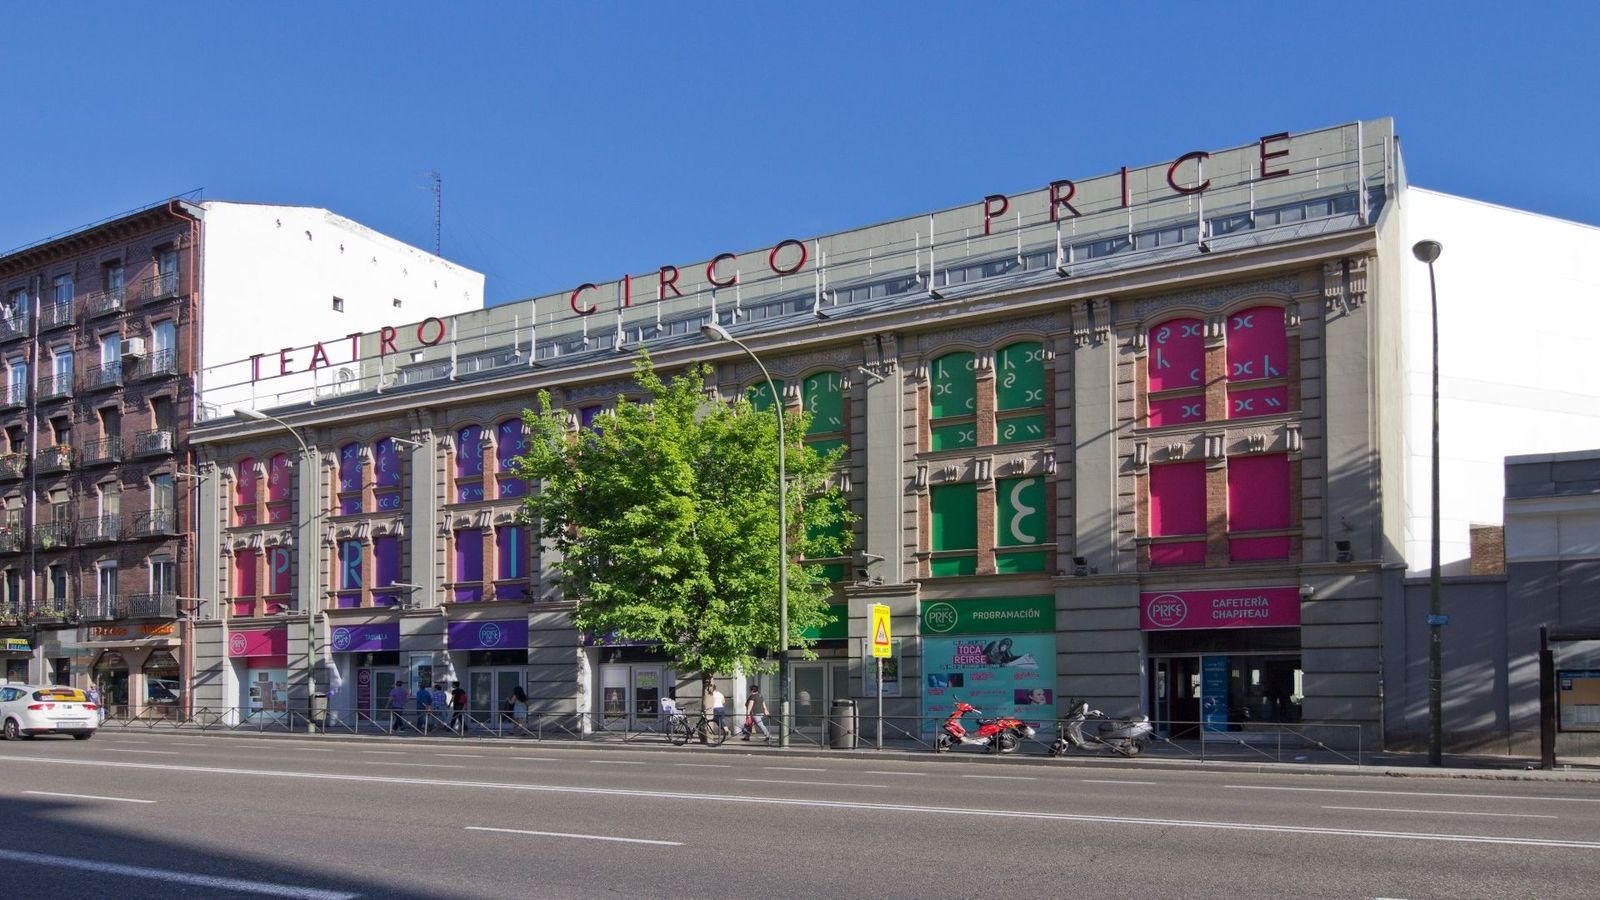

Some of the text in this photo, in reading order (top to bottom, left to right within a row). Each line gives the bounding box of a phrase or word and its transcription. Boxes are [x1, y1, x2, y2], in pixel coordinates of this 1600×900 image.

[250, 131, 1289, 381] TEATRO CIRCO PRICE
[1212, 595, 1269, 608] CAFETERÍA
[972, 608, 1040, 620] PROGRAMACIÓN
[1212, 608, 1269, 620] CHAPITEAU
[959, 645, 982, 655] TOCA
